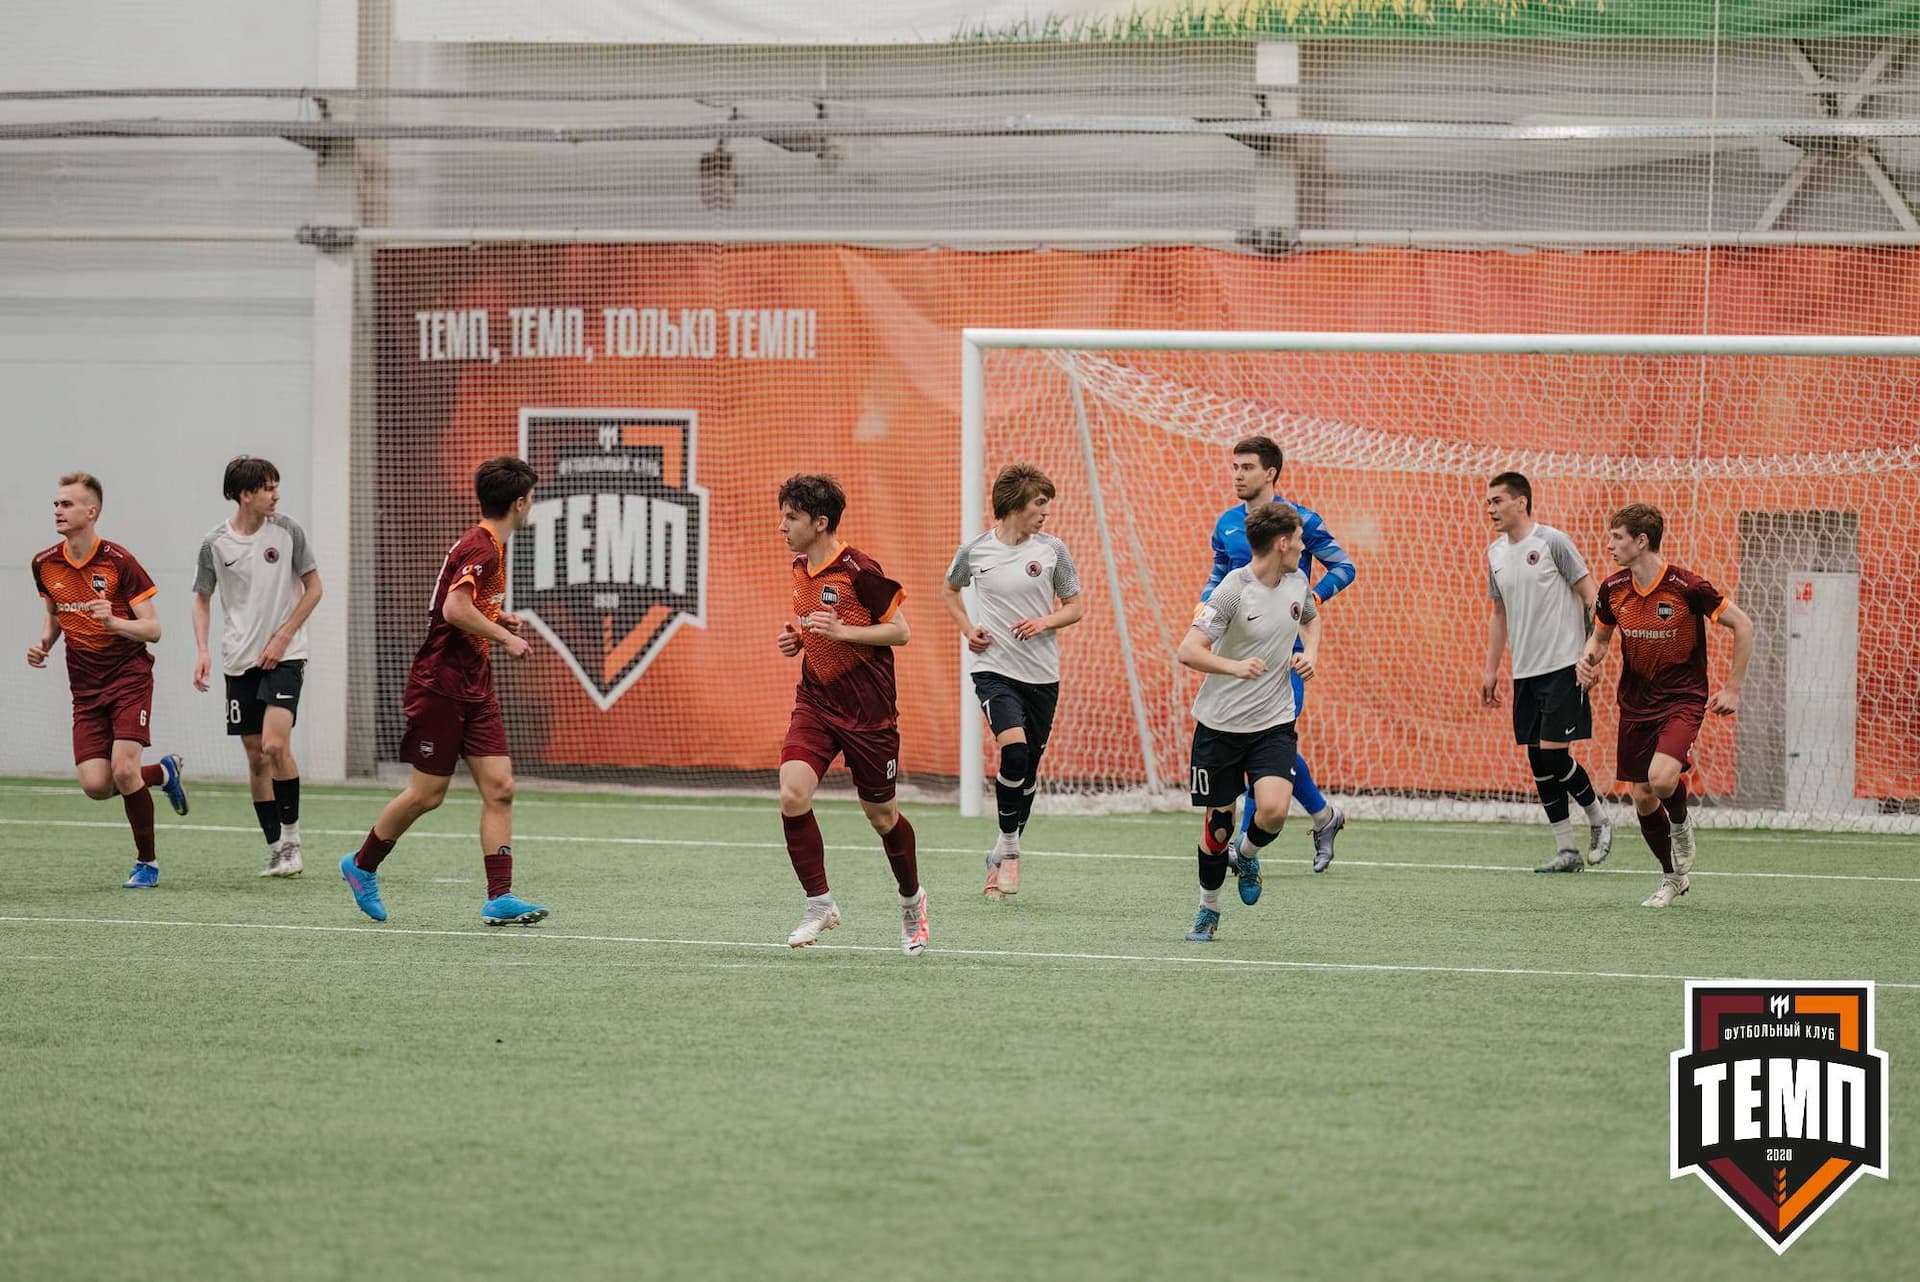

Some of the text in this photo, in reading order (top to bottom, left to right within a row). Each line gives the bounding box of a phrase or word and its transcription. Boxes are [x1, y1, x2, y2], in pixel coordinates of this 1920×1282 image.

[415, 307, 817, 365] ТЕМП, ТЕМП, ТОЛЬКО ТЕМП!
[527, 493, 688, 596] ТЕМП
[139, 710, 147, 727] 6
[886, 758, 897, 780] 21
[1191, 766, 1210, 796] 10
